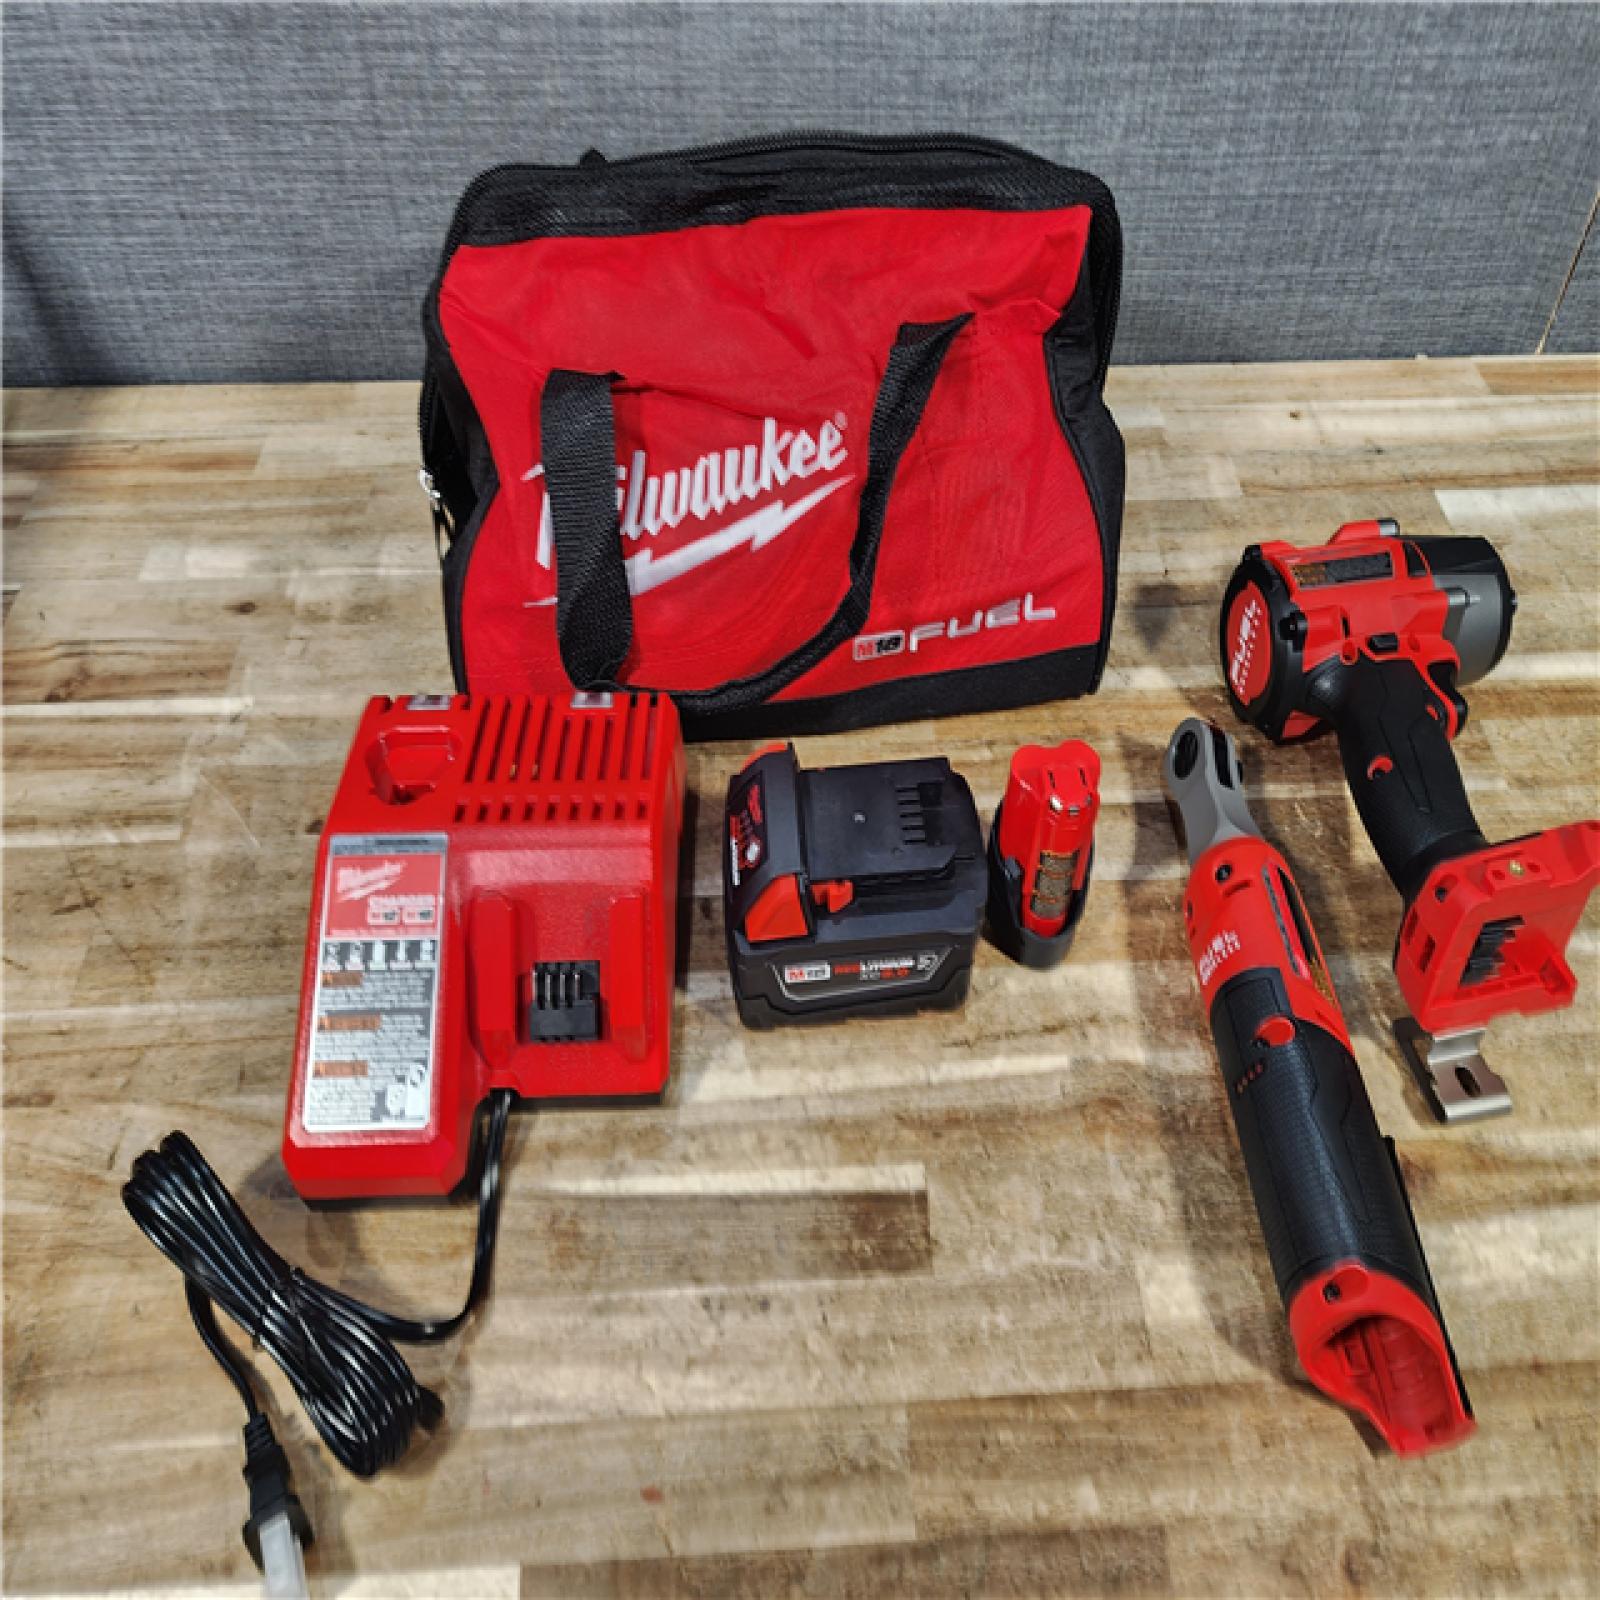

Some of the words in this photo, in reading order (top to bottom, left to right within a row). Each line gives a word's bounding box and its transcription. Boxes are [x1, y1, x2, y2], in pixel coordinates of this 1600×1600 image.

[521, 415, 848, 570] ilwaukee
[856, 633, 904, 659] M18
[908, 592, 1056, 652] FUEL
